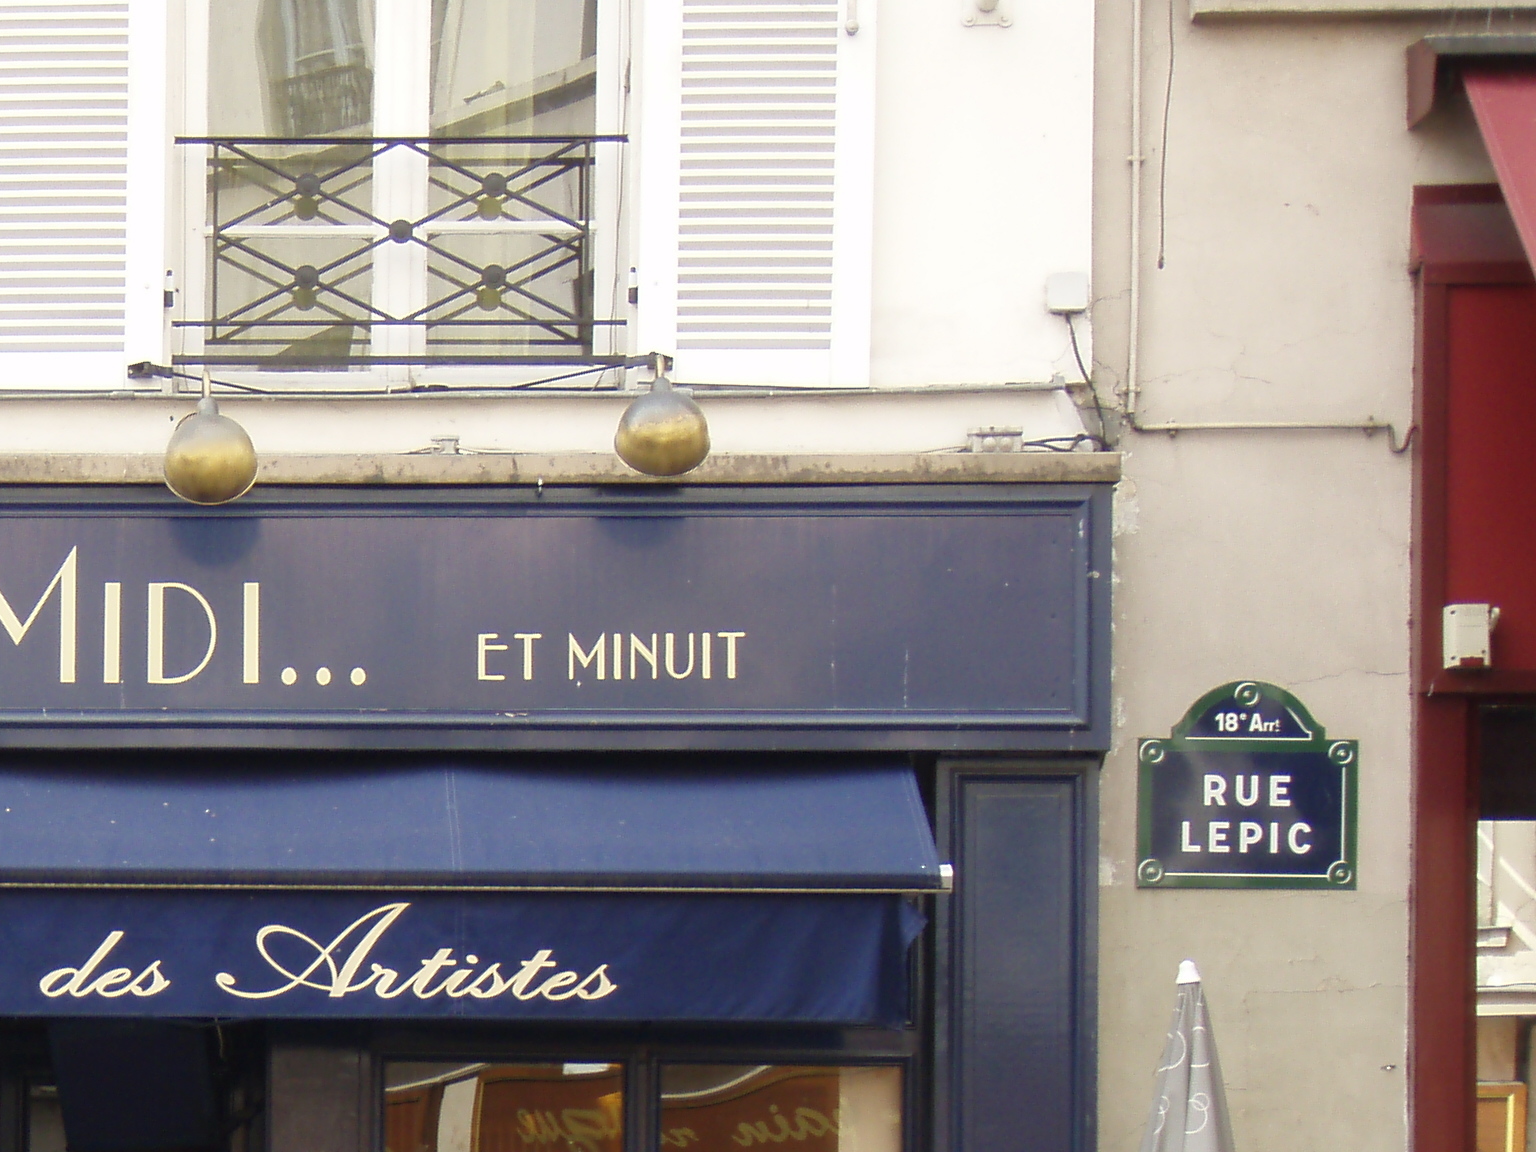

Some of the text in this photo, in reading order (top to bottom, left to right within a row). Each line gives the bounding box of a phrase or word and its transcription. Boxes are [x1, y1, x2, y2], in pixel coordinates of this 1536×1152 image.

[476, 630, 747, 682] ET MINUIT
[1203, 774, 1292, 808] RUE
[1181, 821, 1313, 855] LEPIC
[39, 930, 172, 998] des
[216, 902, 618, 1001] Artistes
